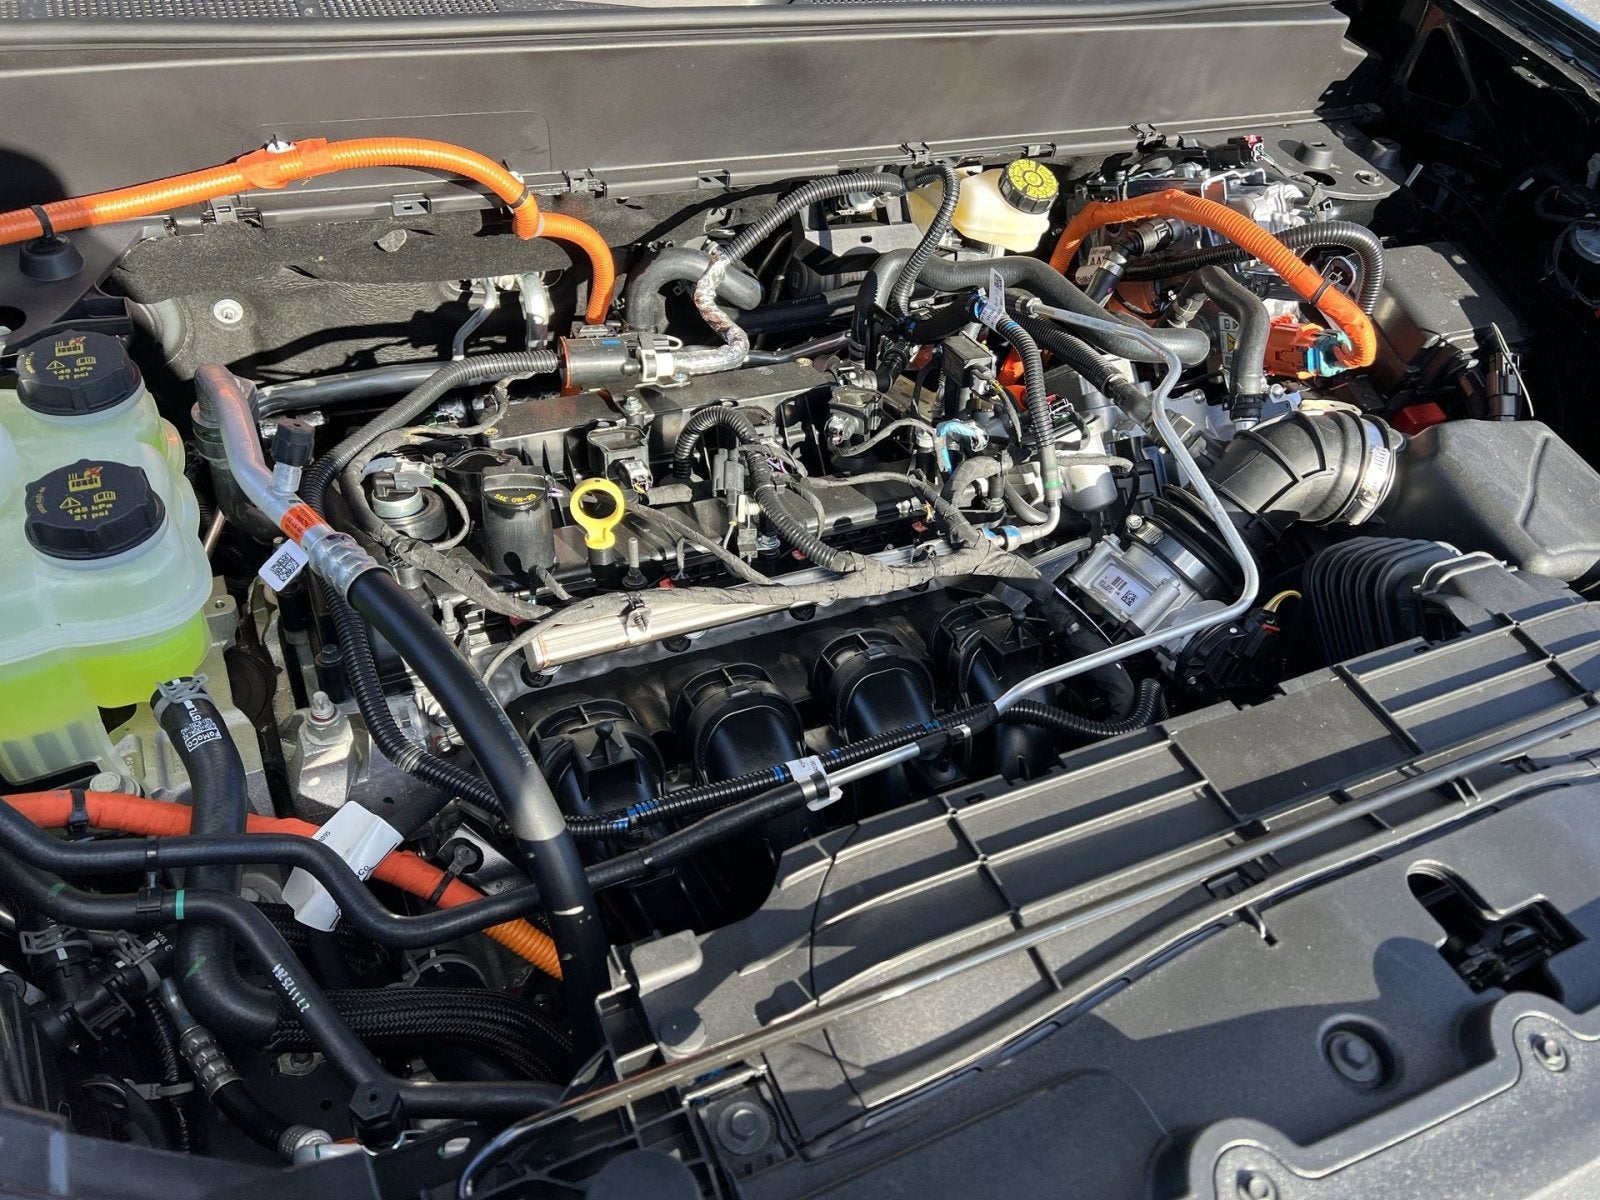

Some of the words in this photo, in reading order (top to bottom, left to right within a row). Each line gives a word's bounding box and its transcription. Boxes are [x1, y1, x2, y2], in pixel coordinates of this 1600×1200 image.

[67, 506, 88, 515] 145
[91, 502, 113, 510] kPa
[91, 510, 109, 519] psi
[186, 729, 221, 749] FoMoCo
